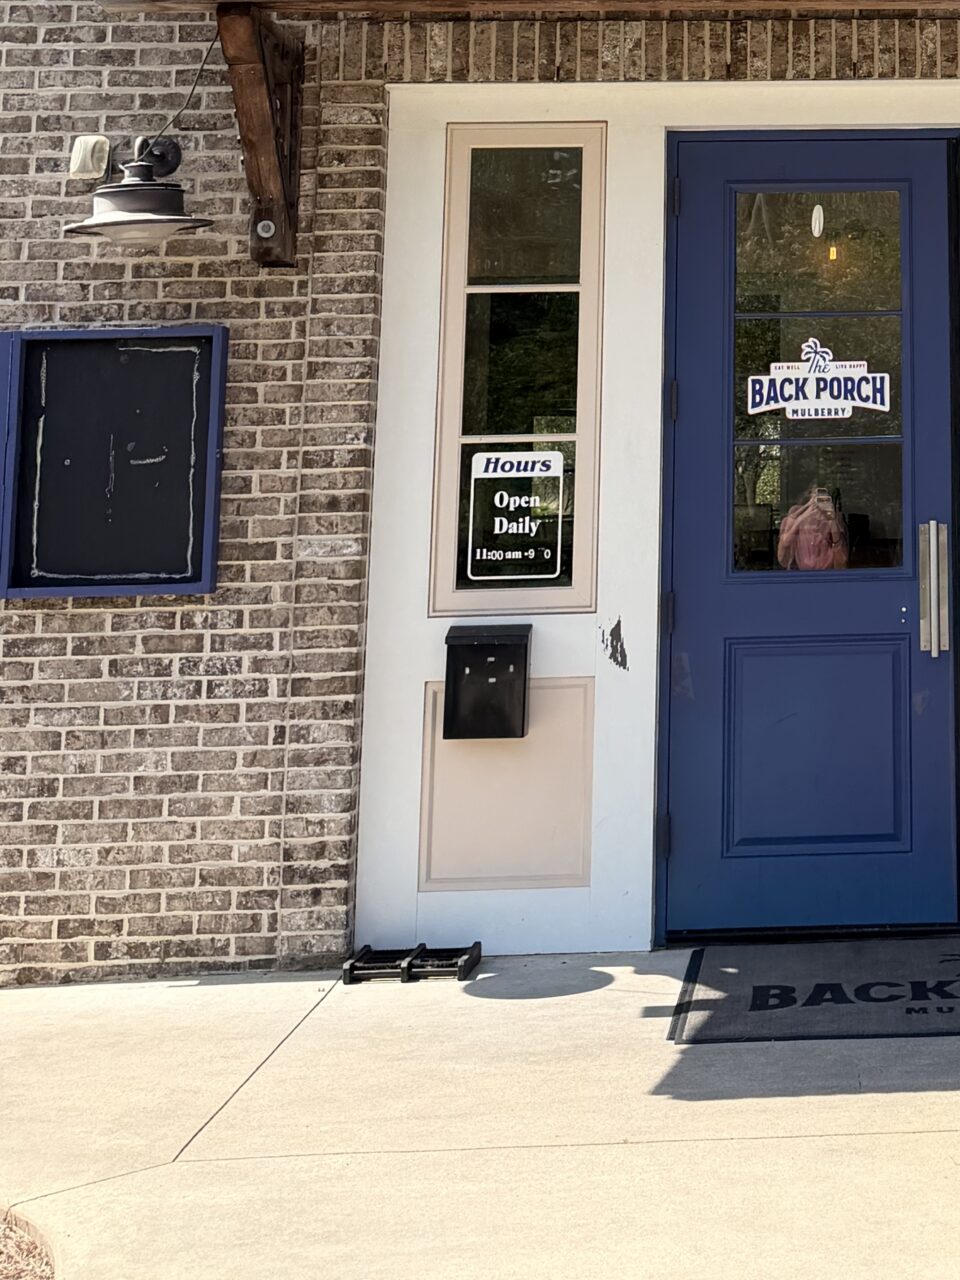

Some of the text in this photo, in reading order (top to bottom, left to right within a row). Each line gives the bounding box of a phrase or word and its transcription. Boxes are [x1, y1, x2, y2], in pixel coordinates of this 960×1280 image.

[750, 375, 886, 410] BACK PORCH
[791, 407, 847, 418] MULBERRY
[482, 456, 552, 474] Hours
[493, 490, 541, 512] Open
[493, 515, 542, 538] Daily
[475, 548, 504, 561] 11:00
[504, 550, 523, 560] am
